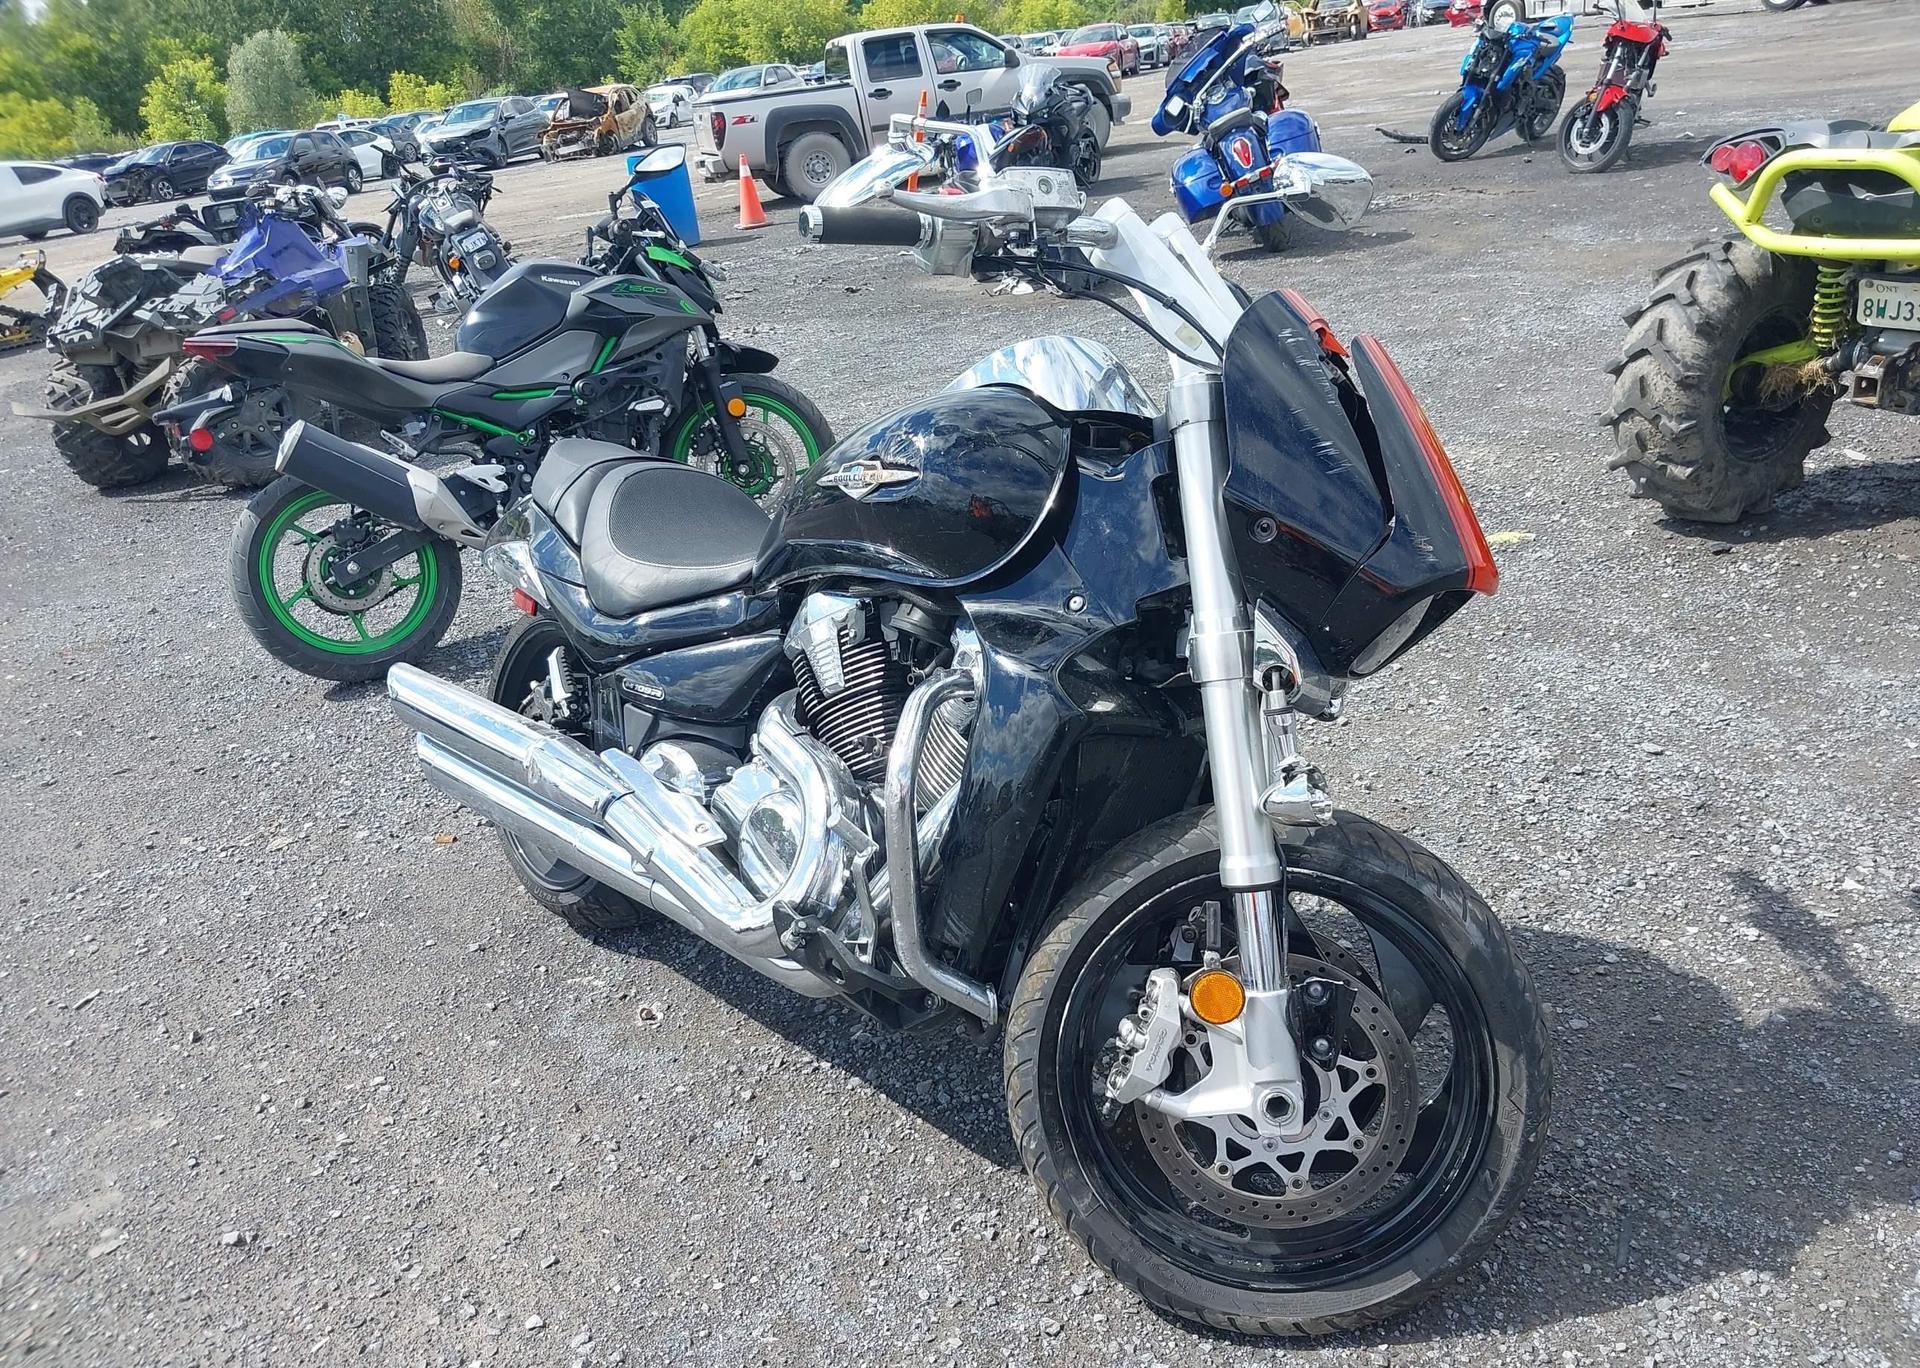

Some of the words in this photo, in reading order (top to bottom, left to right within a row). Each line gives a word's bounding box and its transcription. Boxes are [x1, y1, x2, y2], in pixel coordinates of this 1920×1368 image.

[540, 275, 581, 287] Kawasaki
[612, 283, 668, 294] Z500
[1863, 298, 1920, 322] 8WJ3
